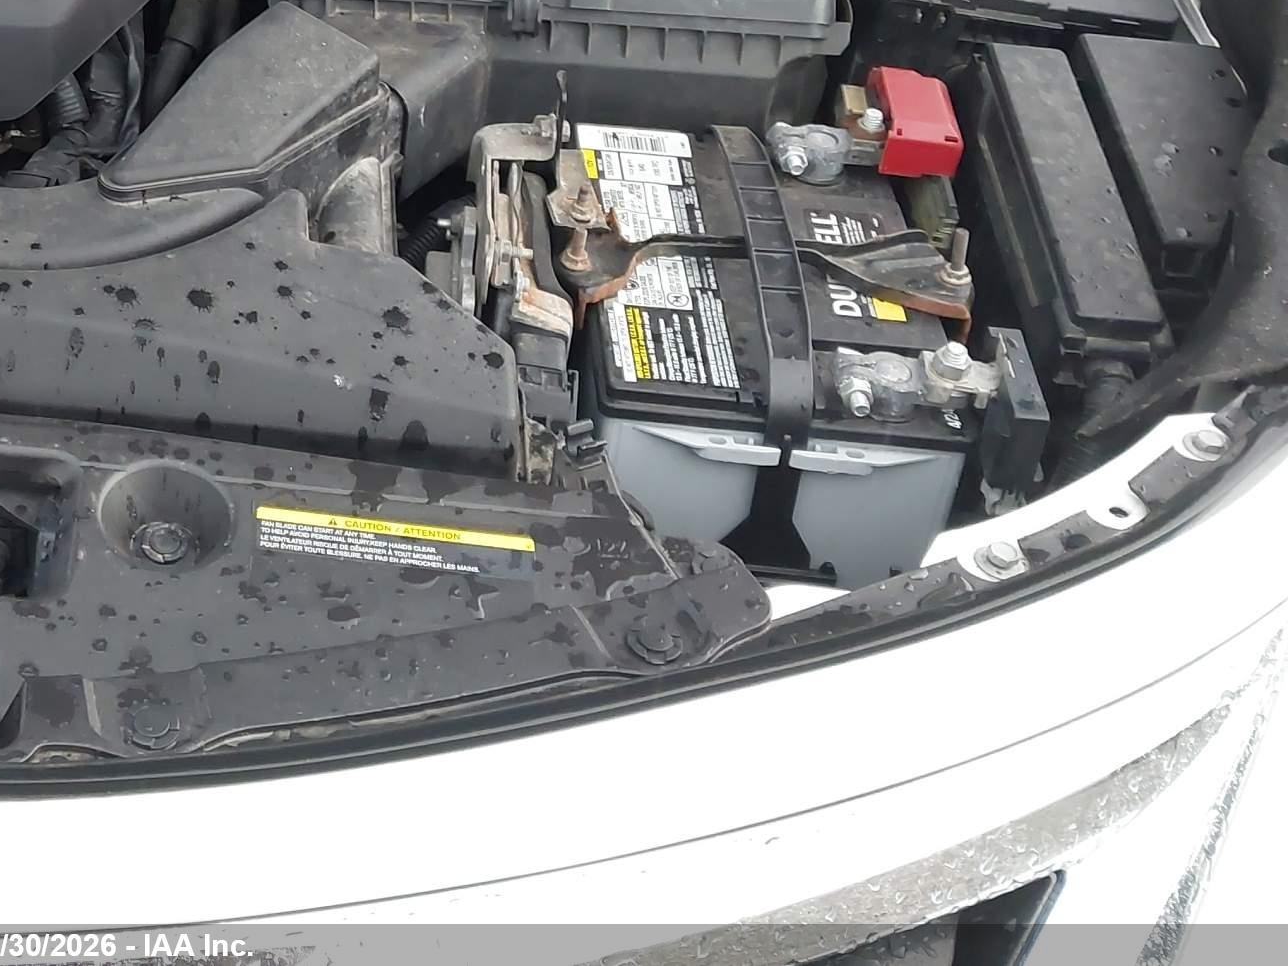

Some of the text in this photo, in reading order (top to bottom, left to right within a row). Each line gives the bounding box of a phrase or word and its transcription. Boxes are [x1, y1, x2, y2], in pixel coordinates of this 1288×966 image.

[276, 522, 297, 530] BLADE
[314, 525, 334, 533] START
[344, 529, 359, 537] ANY
[345, 521, 391, 532] CAUTION
[403, 528, 461, 540] ATTENTION
[290, 530, 310, 539] AVOID
[311, 533, 346, 543] PERSONAL
[389, 542, 412, 551] HANDS
